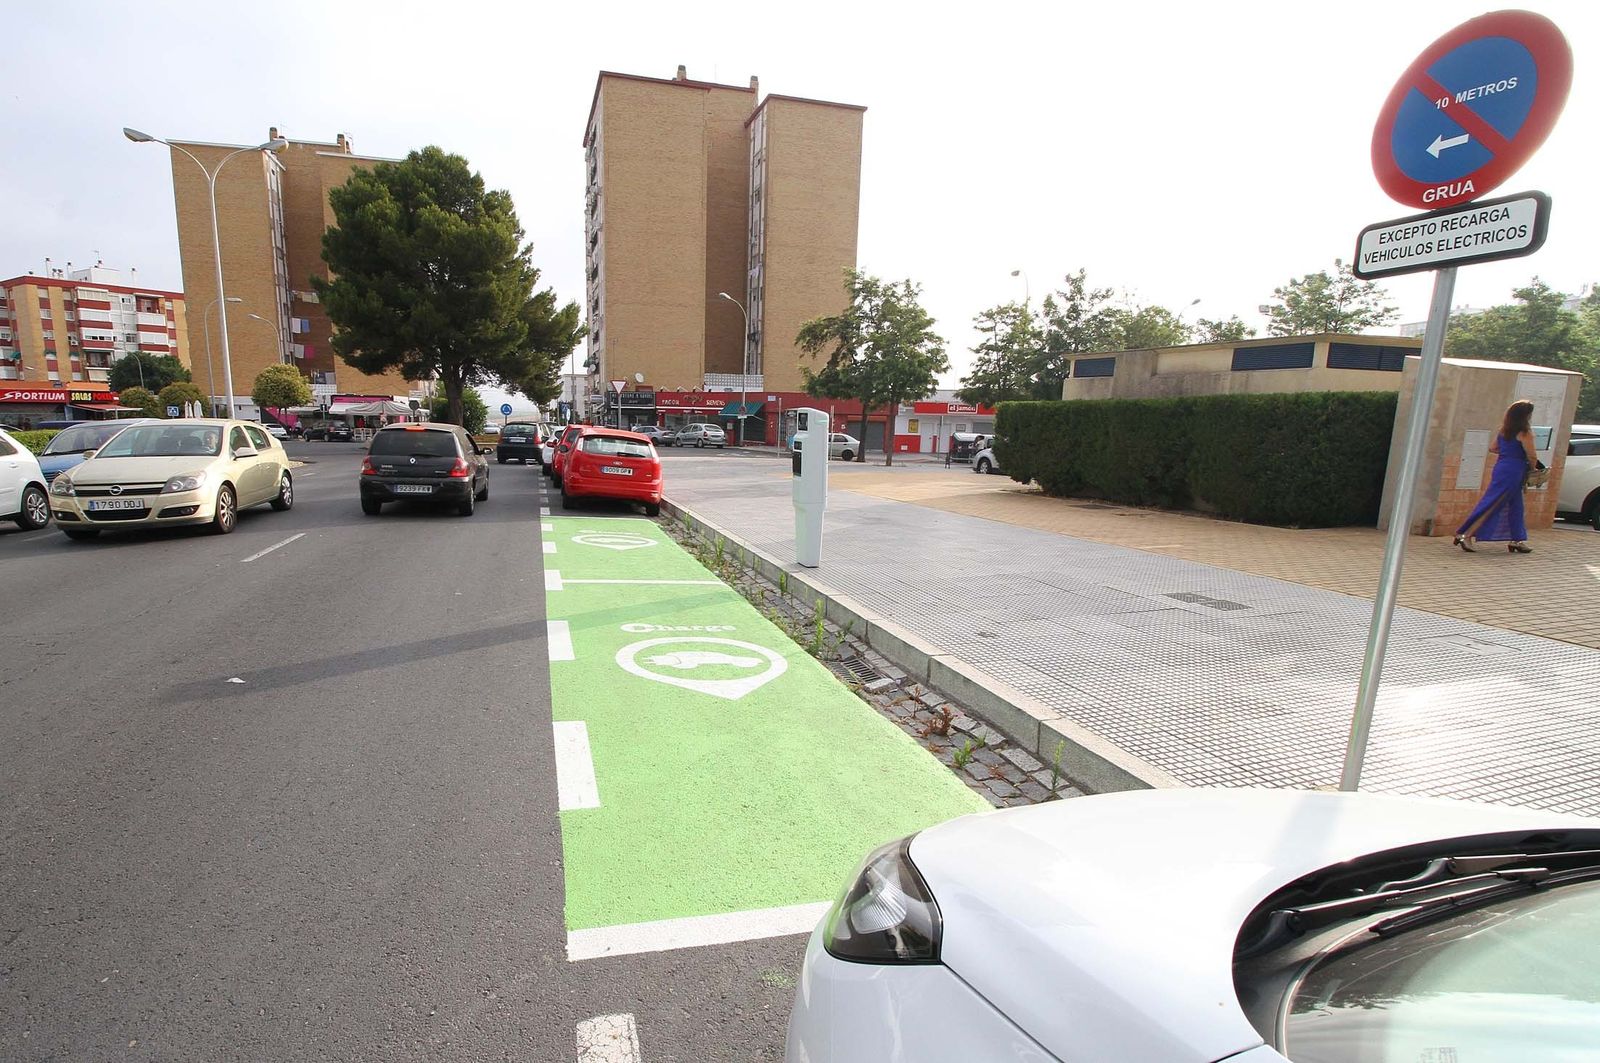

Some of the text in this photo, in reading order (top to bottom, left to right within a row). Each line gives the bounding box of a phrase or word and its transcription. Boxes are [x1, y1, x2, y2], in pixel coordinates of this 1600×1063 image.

[1434, 77, 1517, 110] 10 METROS
[1422, 180, 1475, 203] GRUA
[1378, 206, 1511, 246] EXCEPTO RECARGA
[1363, 224, 1528, 265] VEHICULOS ELECTRICOS
[96, 500, 141, 510] 1790 DDJ
